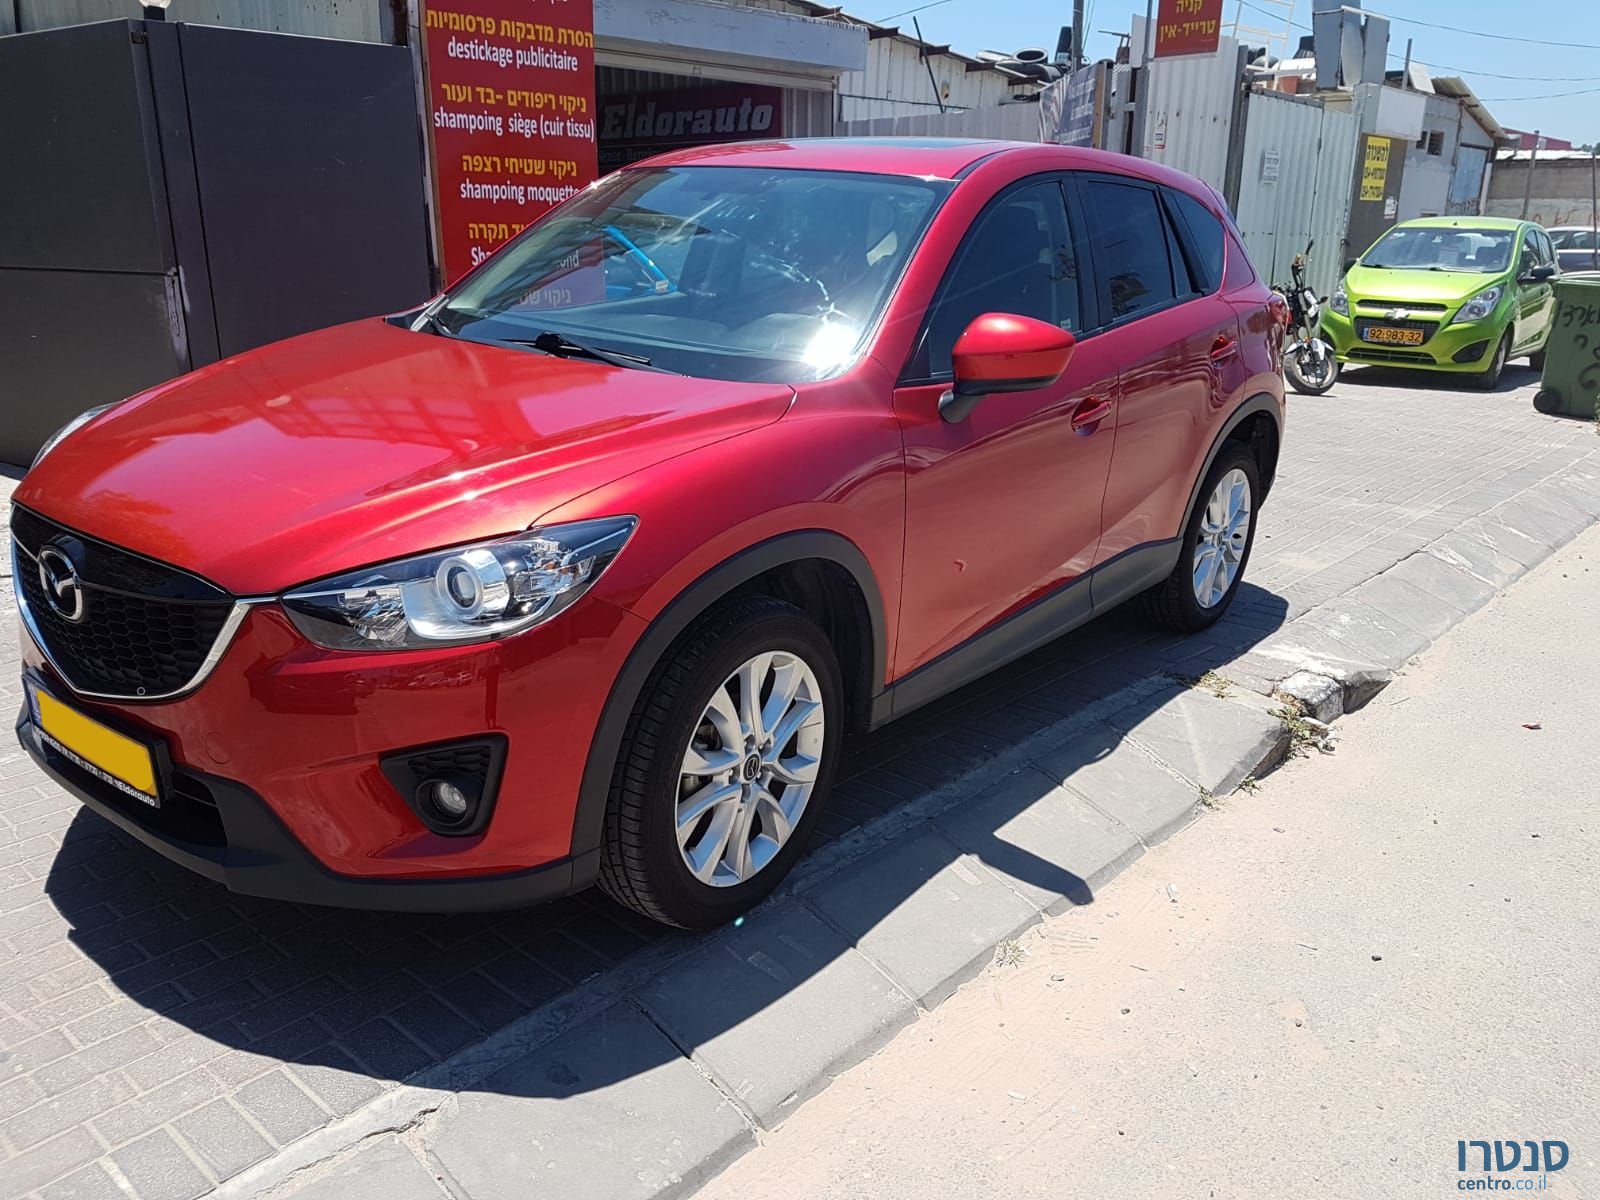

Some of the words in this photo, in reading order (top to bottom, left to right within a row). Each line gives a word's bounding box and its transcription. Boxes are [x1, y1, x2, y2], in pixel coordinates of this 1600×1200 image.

[426, 9, 496, 35] פרסומיות
[500, 19, 554, 43] מדבקות
[557, 27, 593, 48] הסרת
[447, 35, 513, 67] destickage
[516, 45, 578, 72] publicitaire
[441, 83, 472, 102] ועור
[507, 89, 556, 110] ריפודים
[559, 95, 586, 115] ניקוי
[434, 106, 503, 136] shampoing
[508, 112, 537, 138] siège
[540, 114, 564, 139] (cuir
[566, 118, 594, 143] tissu)
[600, 98, 773, 140] Eldorauto
[462, 154, 501, 173] רצפה
[504, 157, 546, 177] שטיחי
[549, 160, 577, 180] ניקוי
[460, 178, 525, 204] shampoing
[468, 223, 509, 243] תקרה
